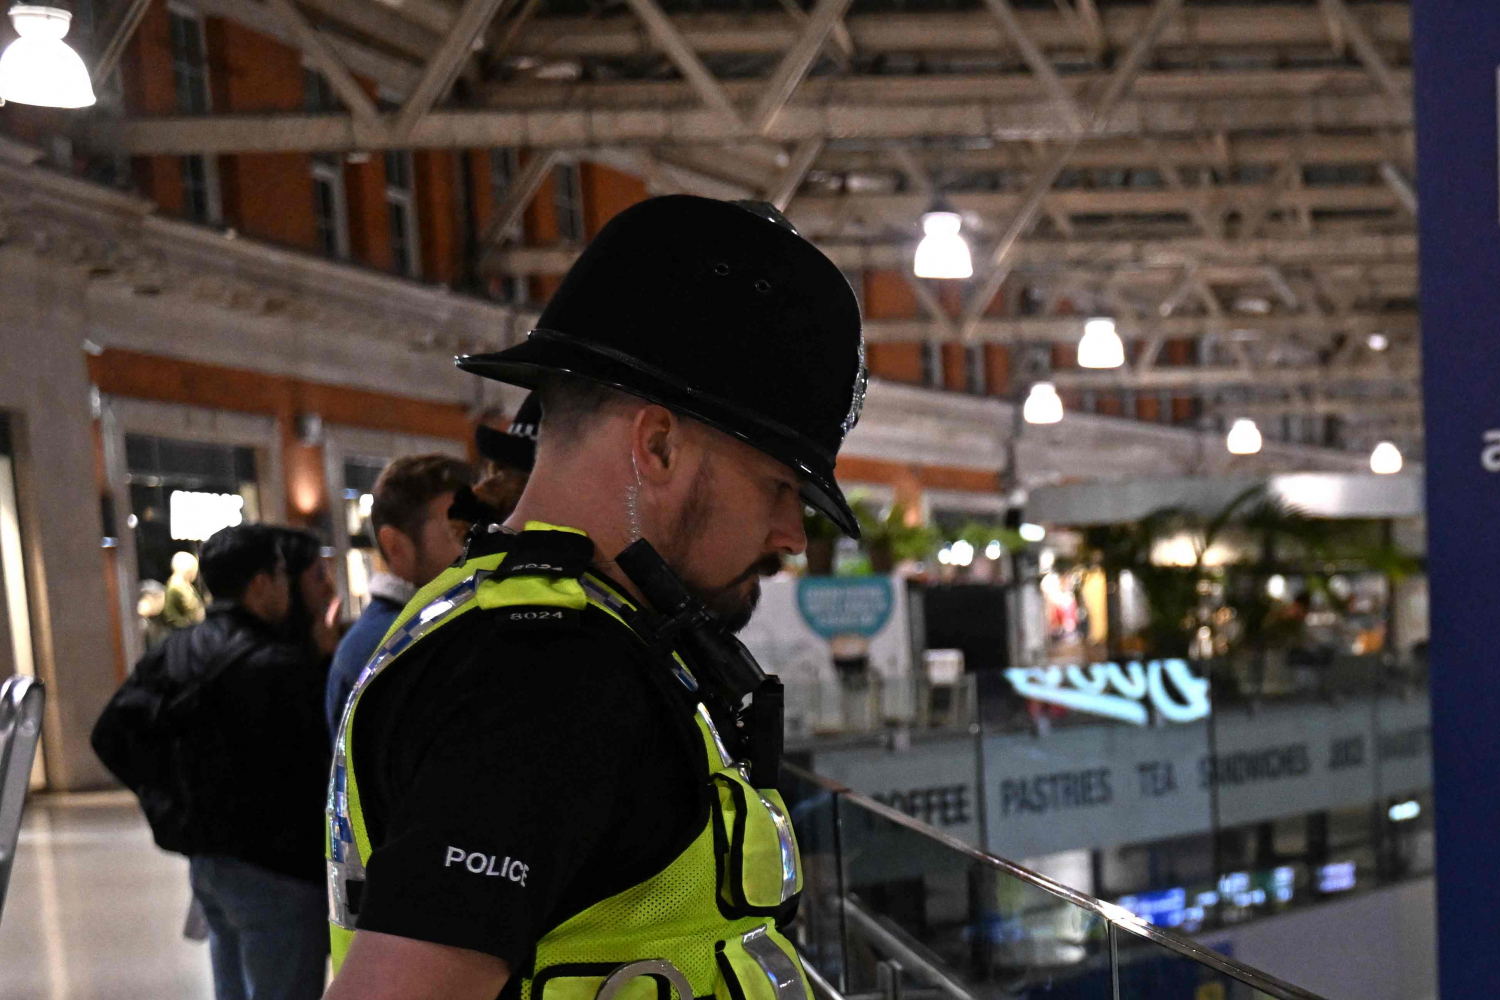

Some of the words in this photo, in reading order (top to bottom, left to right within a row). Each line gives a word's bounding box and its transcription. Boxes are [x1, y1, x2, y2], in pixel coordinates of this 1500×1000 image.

[510, 611, 563, 621] 8024
[1002, 766, 1113, 816] PASTRIES
[1138, 761, 1177, 796] TEA
[445, 846, 530, 887] POLICE
